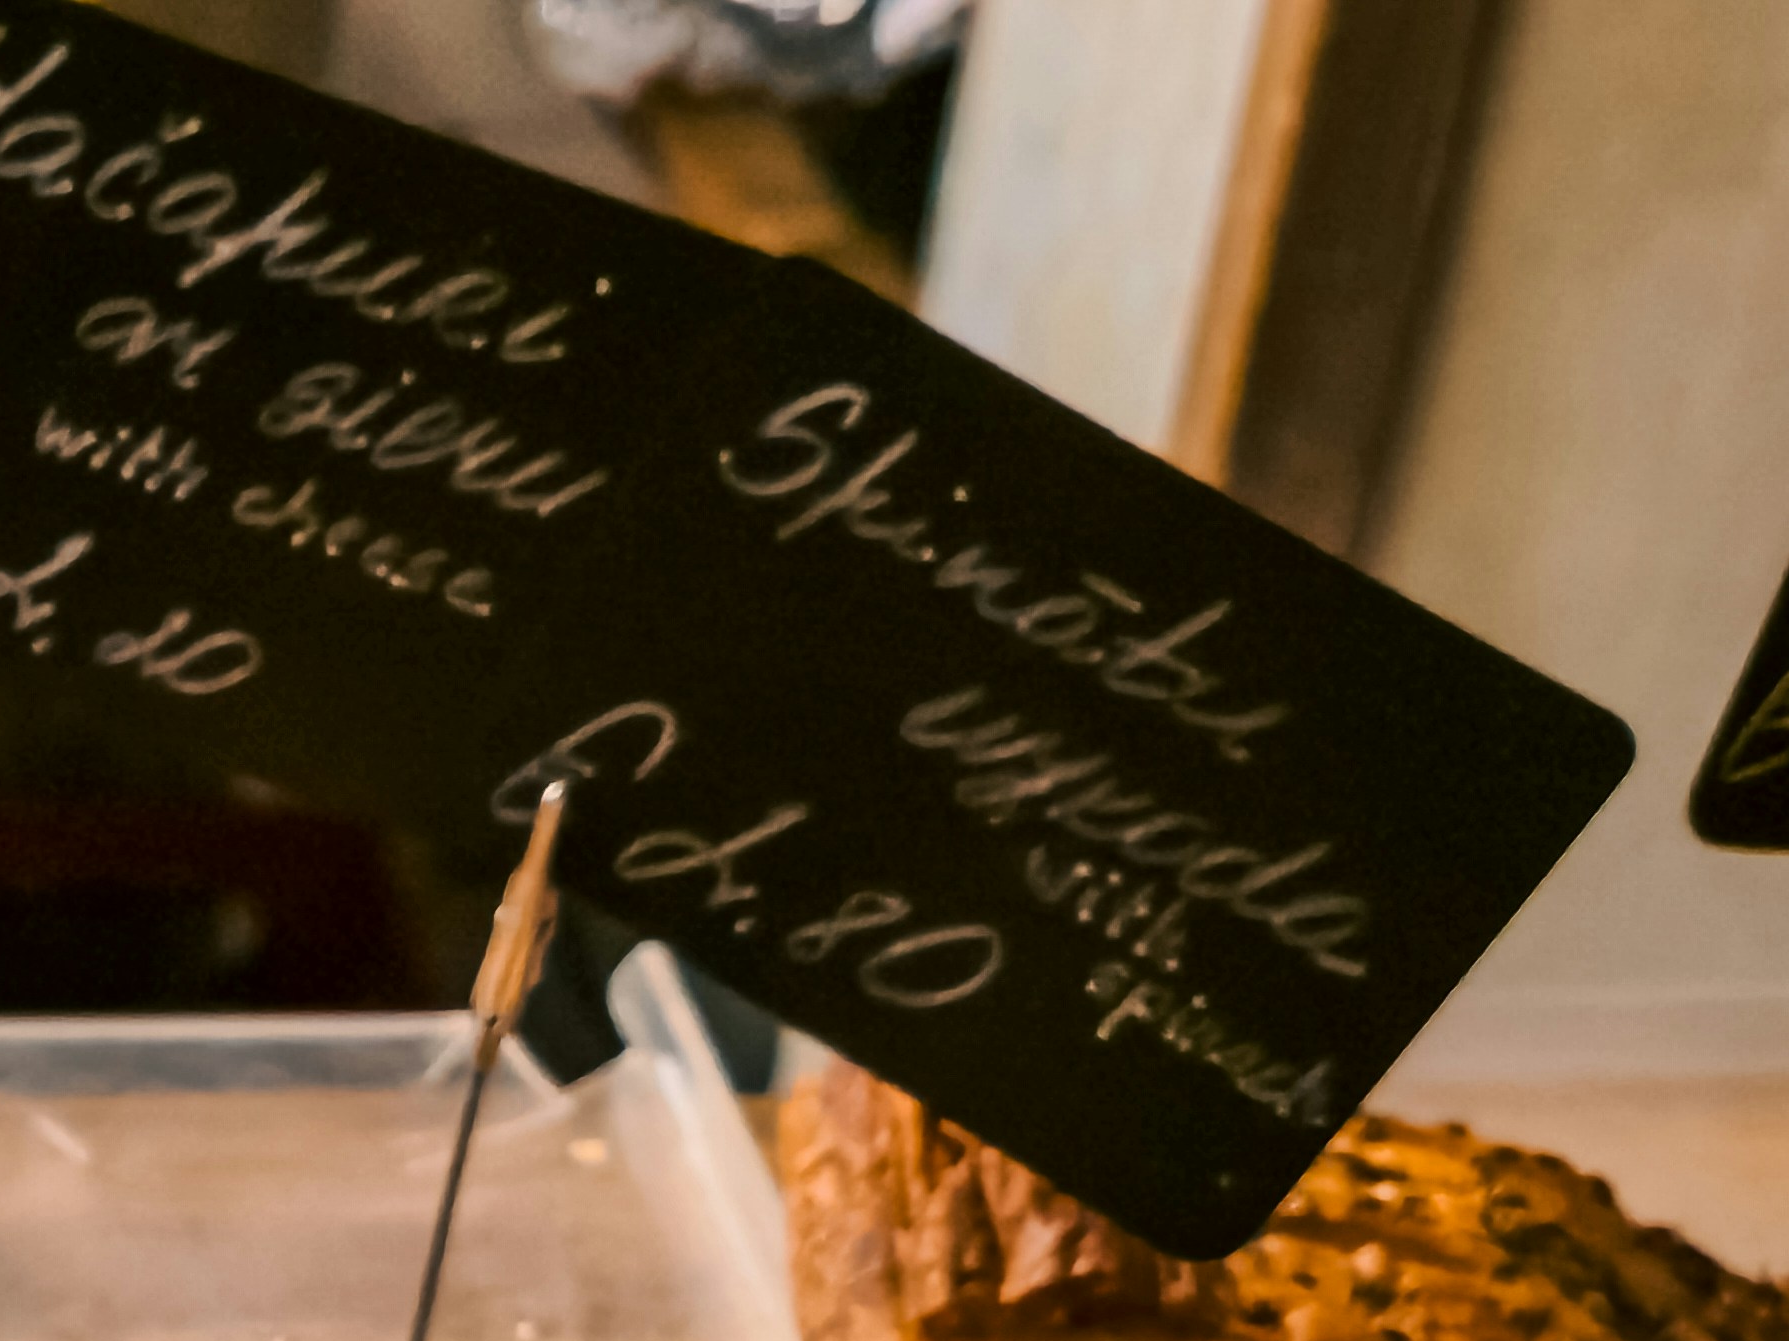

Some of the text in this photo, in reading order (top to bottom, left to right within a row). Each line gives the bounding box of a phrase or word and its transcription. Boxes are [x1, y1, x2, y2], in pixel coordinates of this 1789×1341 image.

[35, 405, 495, 617] with cheese
[75, 295, 610, 518] ar sieru
[1025, 844, 1188, 973] with
